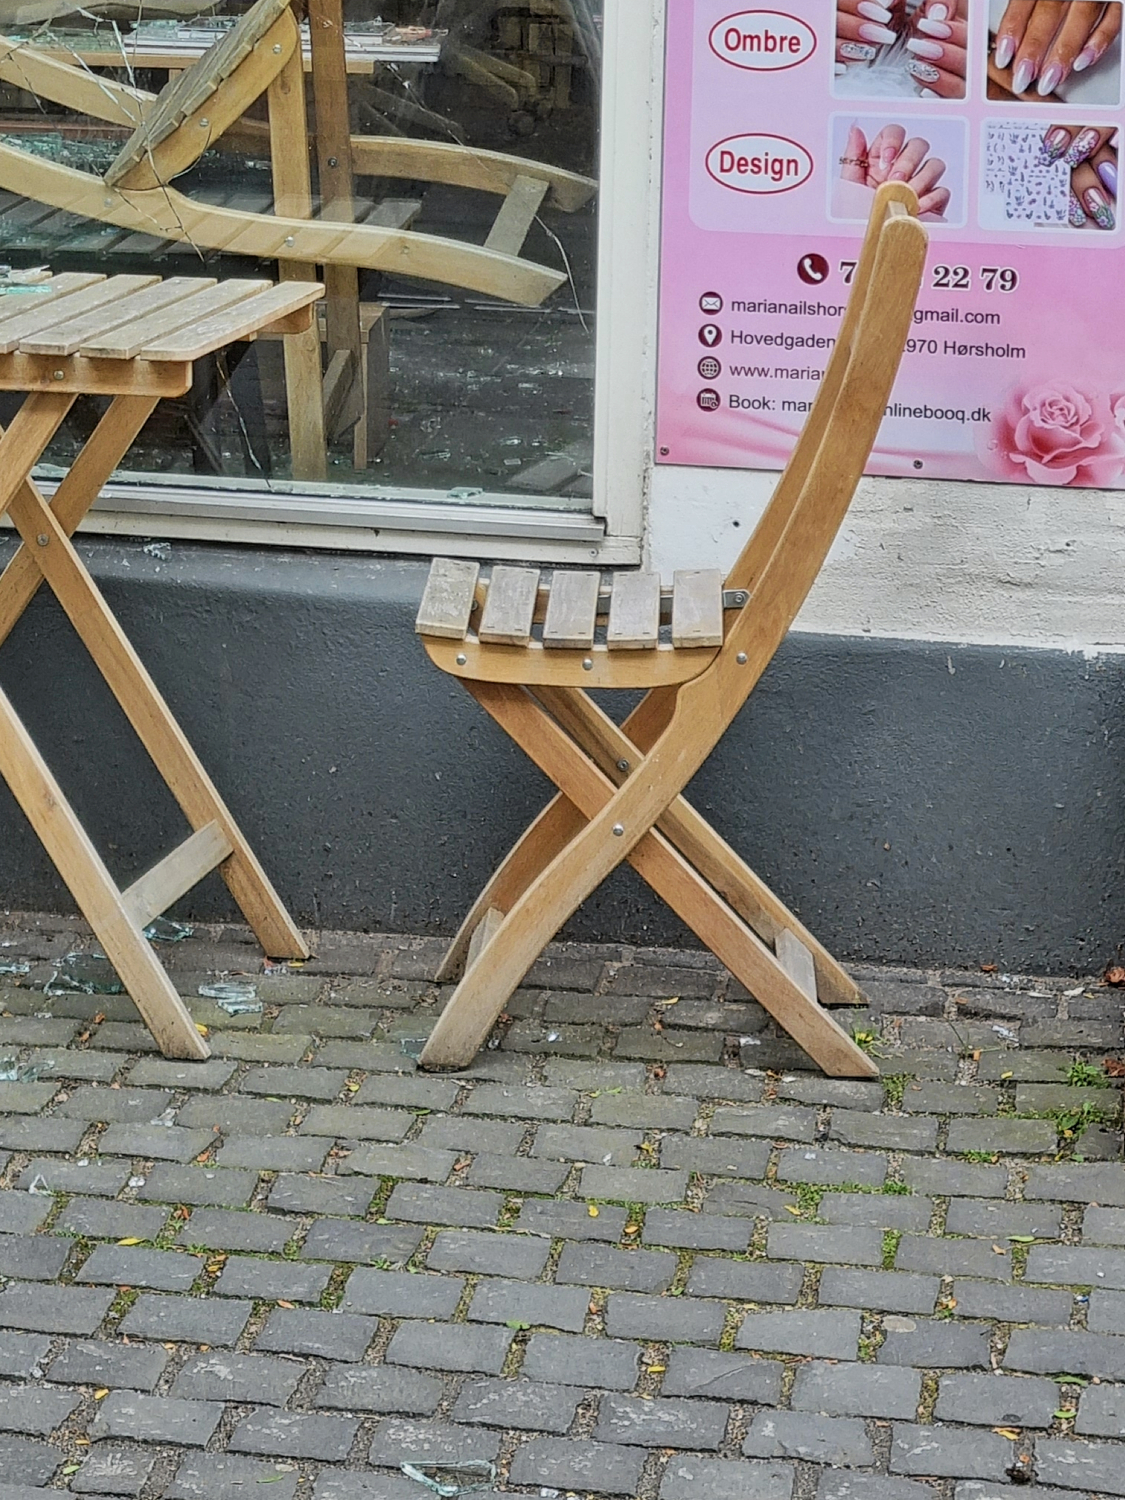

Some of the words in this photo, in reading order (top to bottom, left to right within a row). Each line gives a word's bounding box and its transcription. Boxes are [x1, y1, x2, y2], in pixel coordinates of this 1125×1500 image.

[724, 28, 801, 53] Ombre
[719, 150, 799, 180] Design
[840, 261, 858, 284] 7
[932, 266, 971, 289] 22
[981, 268, 1018, 291] 79
[903, 339, 938, 355] 970
[943, 340, 1026, 358] Hørsholm
[729, 394, 775, 411] Book:
